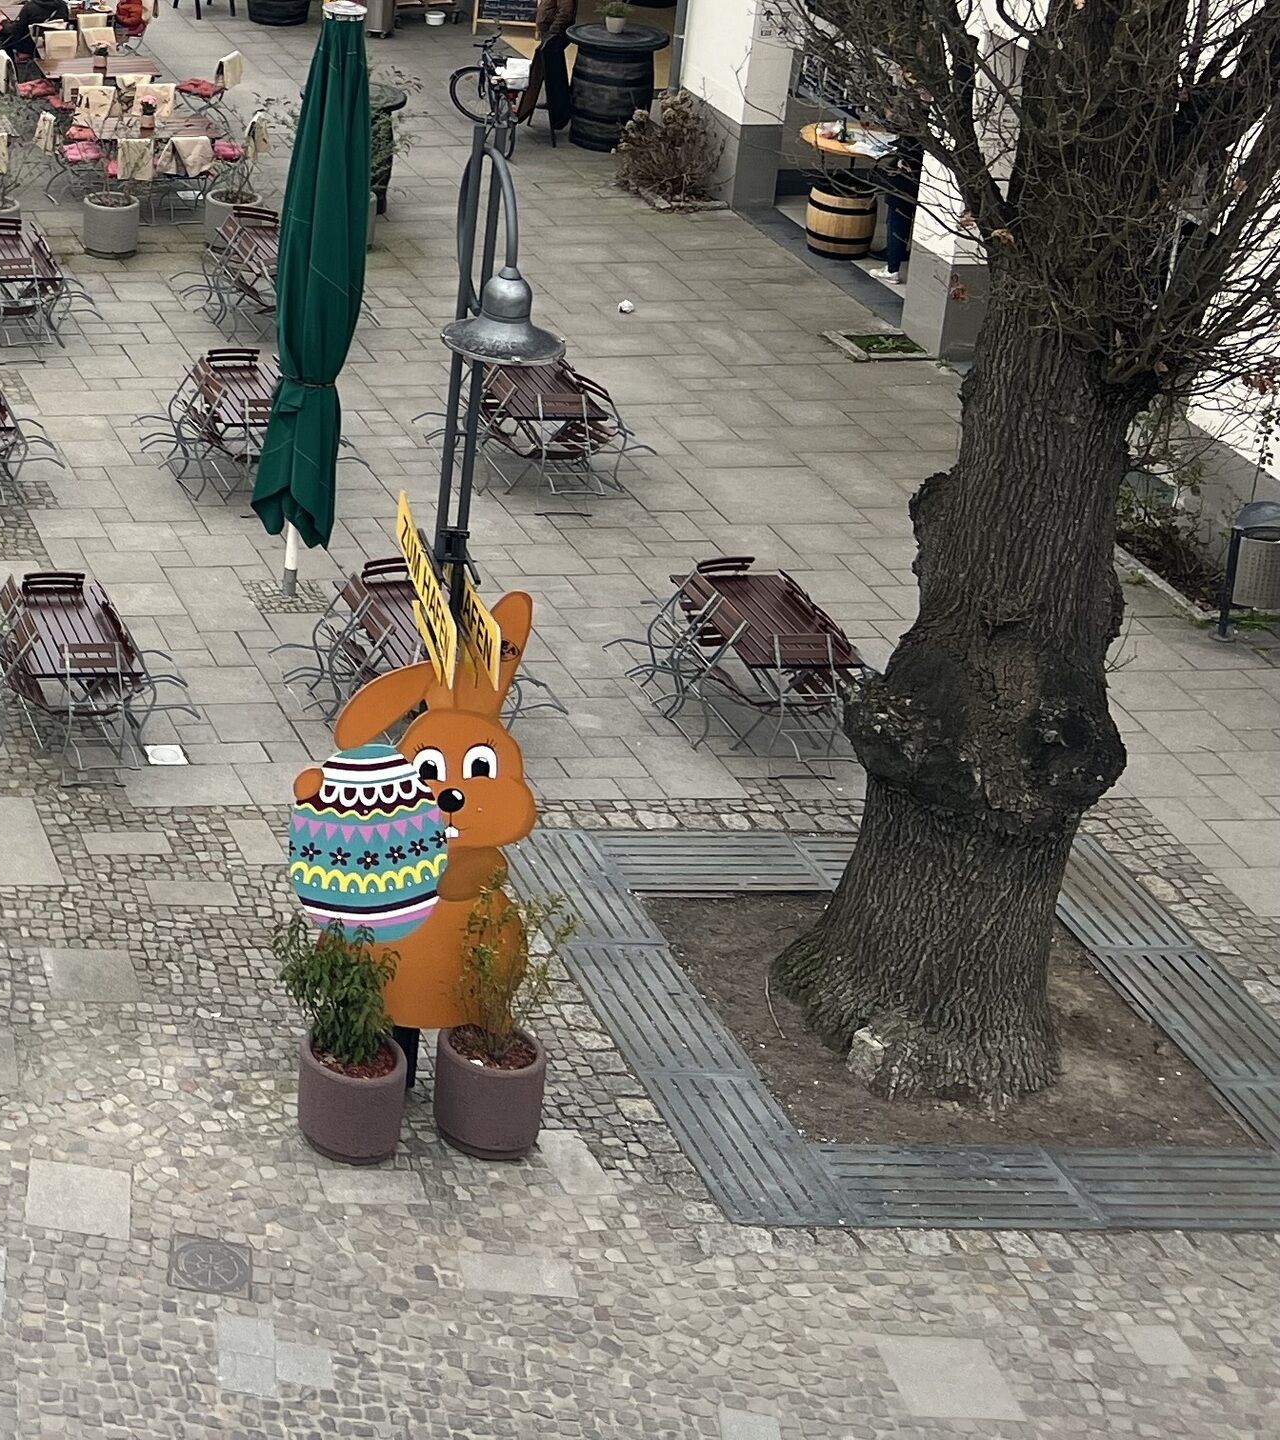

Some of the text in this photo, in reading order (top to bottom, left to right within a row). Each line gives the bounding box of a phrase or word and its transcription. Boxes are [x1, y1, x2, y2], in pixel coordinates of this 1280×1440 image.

[401, 516, 451, 669] ZUM HAFEN
[462, 589, 493, 671] AFEN
